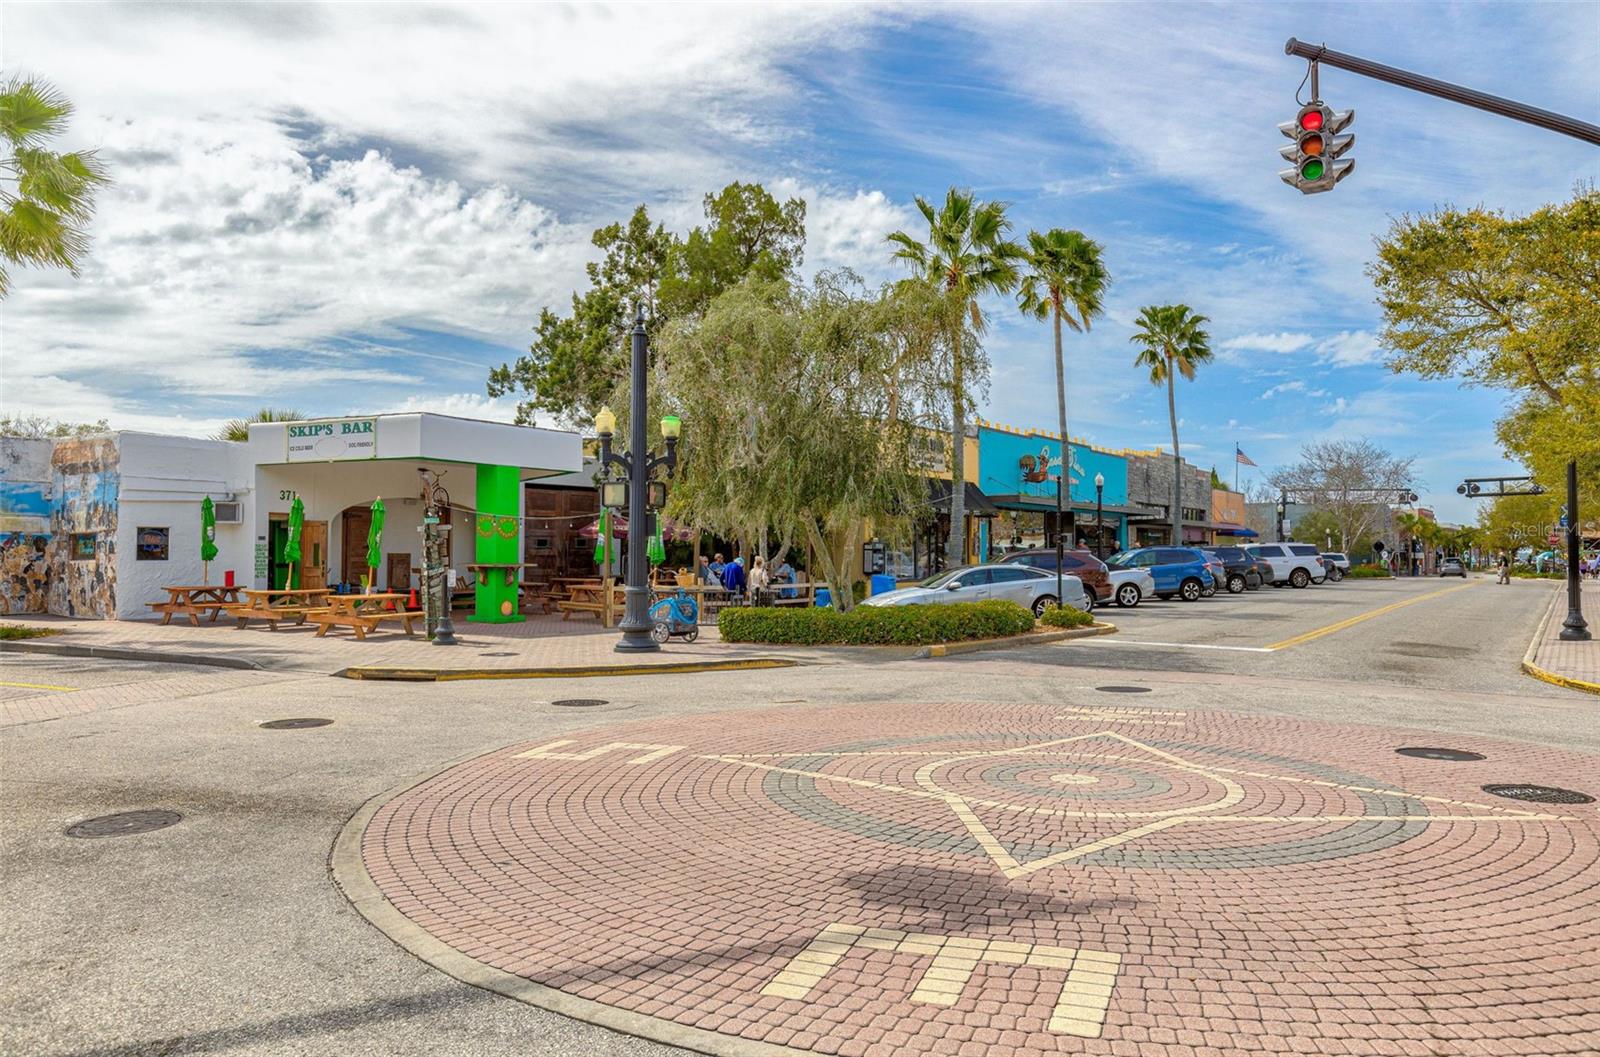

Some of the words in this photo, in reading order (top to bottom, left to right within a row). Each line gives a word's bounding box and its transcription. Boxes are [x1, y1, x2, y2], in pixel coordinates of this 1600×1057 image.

[290, 424, 333, 437] SKIP'S
[342, 422, 373, 434] BAR
[280, 490, 296, 500] 371
[758, 922, 1122, 1038] E
